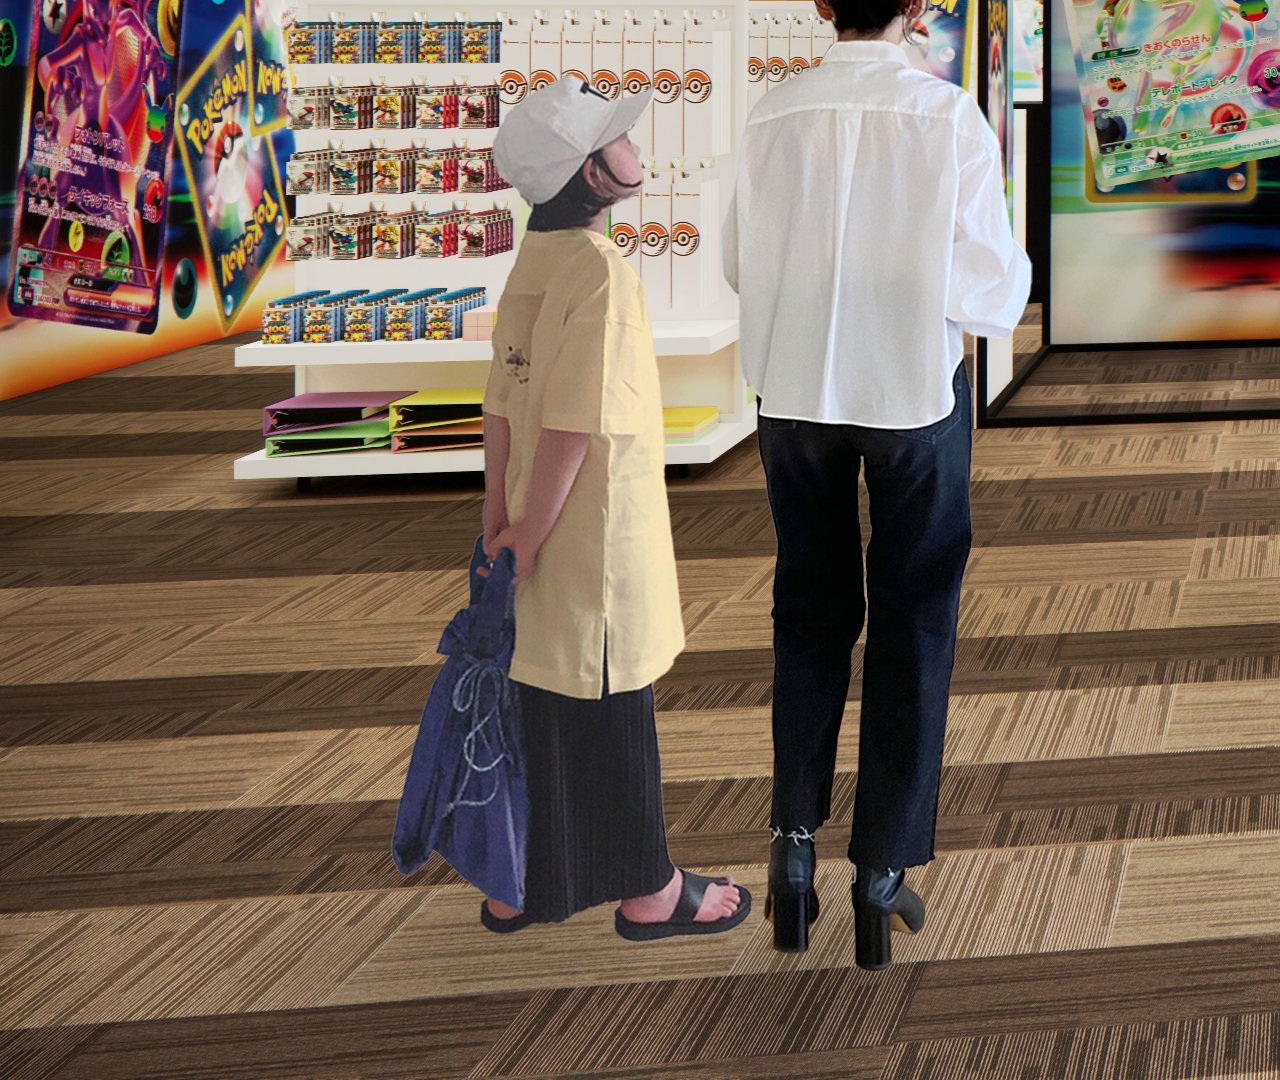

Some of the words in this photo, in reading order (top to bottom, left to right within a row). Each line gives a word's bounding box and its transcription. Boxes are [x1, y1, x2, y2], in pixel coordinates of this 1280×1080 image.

[1143, 34, 1212, 53] きおくのらせん
[1264, 67, 1279, 79] 30
